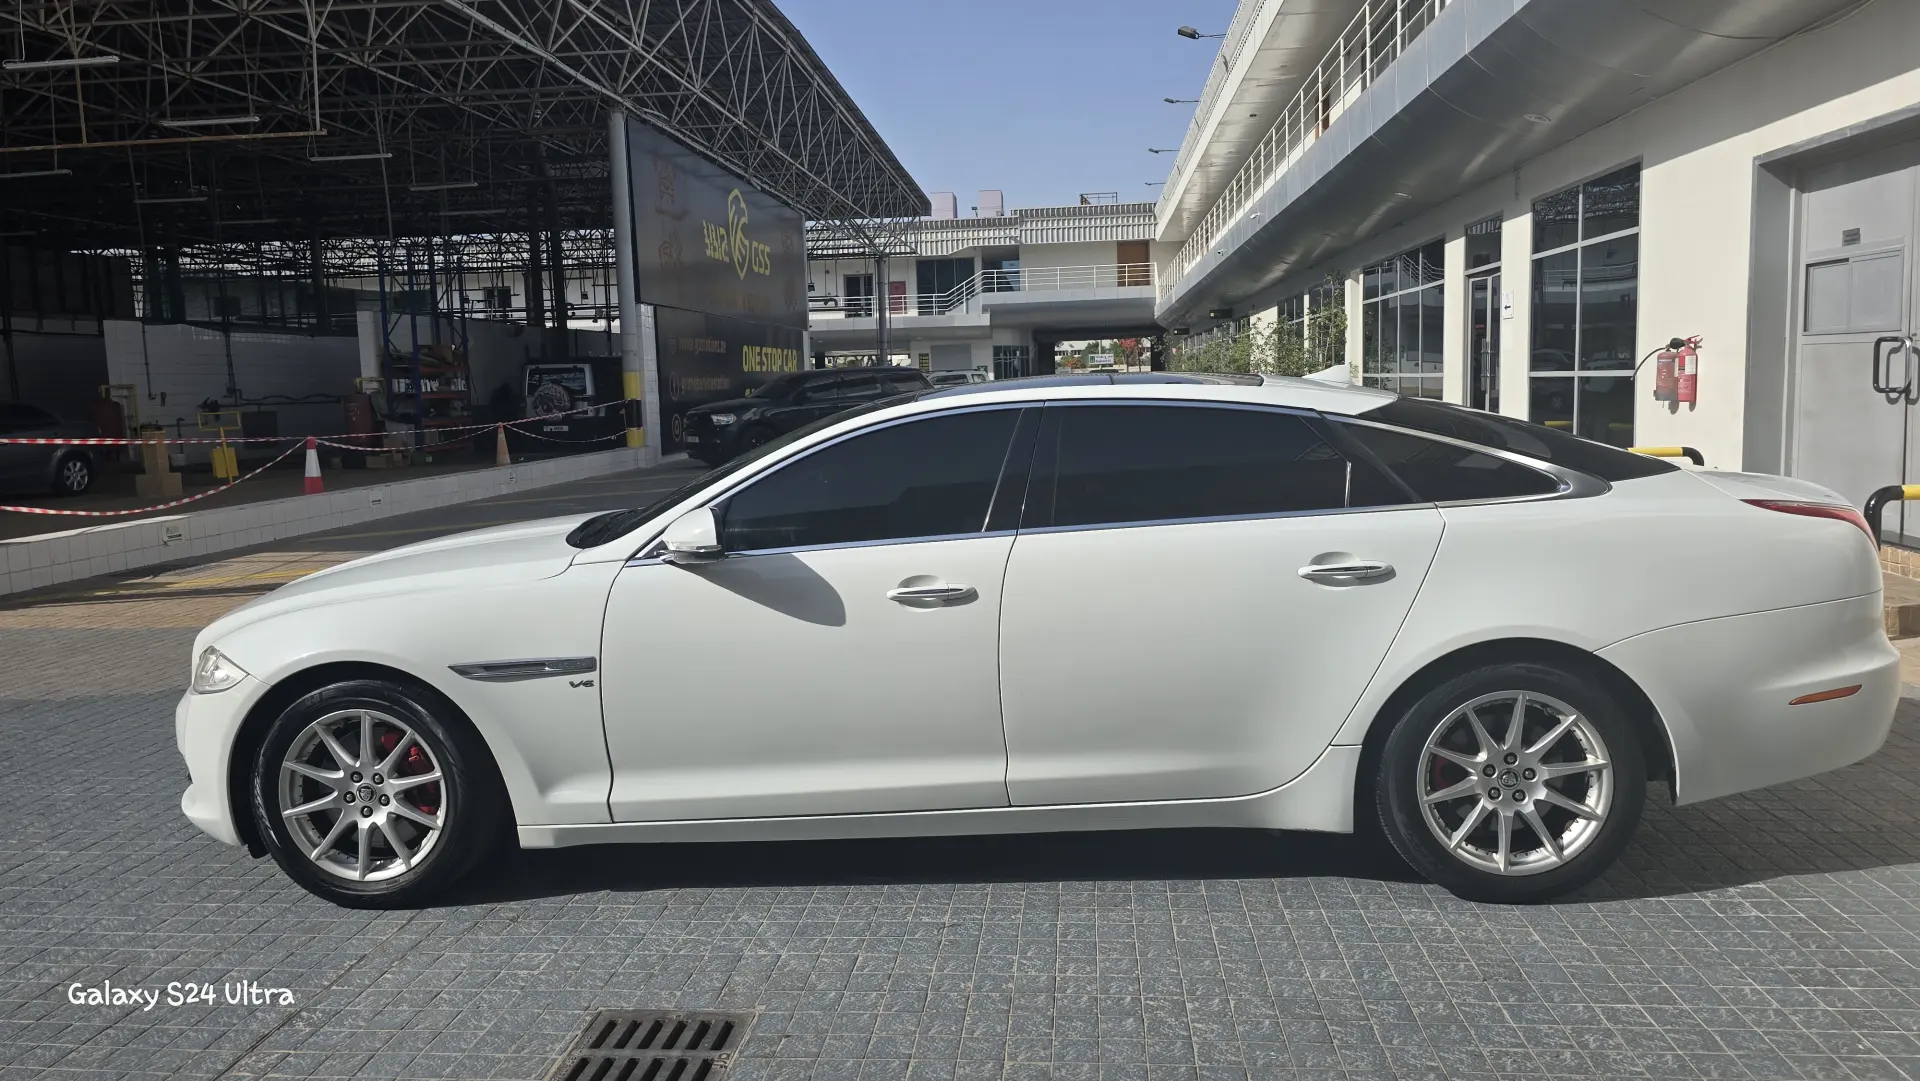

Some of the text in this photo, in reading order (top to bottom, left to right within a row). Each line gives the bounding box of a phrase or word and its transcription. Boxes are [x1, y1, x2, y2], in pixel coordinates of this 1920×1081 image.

[752, 240, 771, 276] GSS
[742, 344, 798, 373] ONE STOP CAR
[569, 680, 595, 688] V6
